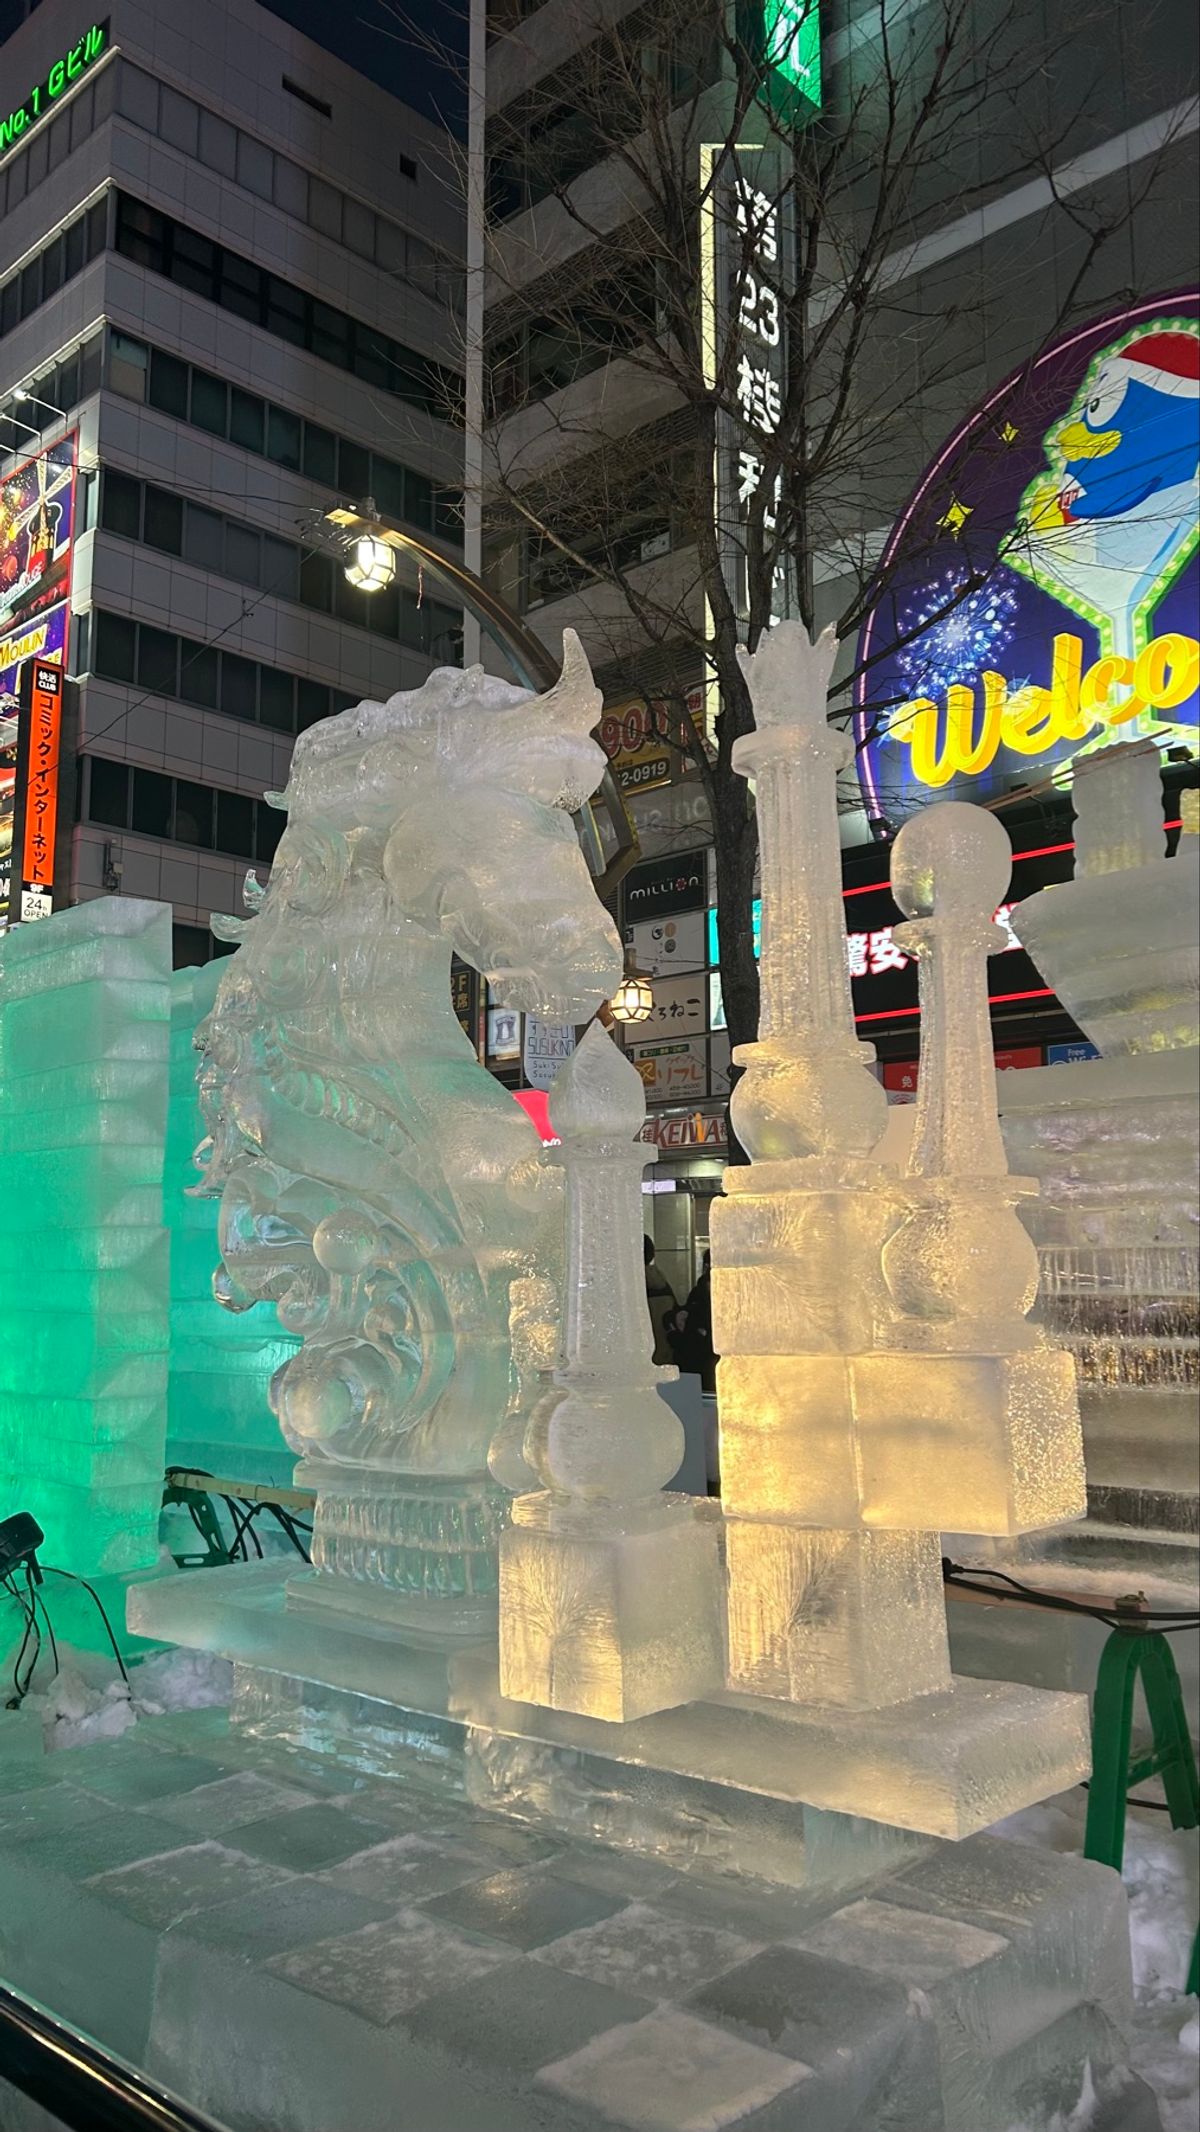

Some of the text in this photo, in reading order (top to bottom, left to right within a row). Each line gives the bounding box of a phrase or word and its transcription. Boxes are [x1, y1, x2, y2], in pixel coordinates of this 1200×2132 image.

[48, 24, 103, 97] Gビル
[38, 681, 57, 691] CLUB
[32, 694, 54, 880] コミック・インターネット
[23, 908, 49, 919] OPEN
